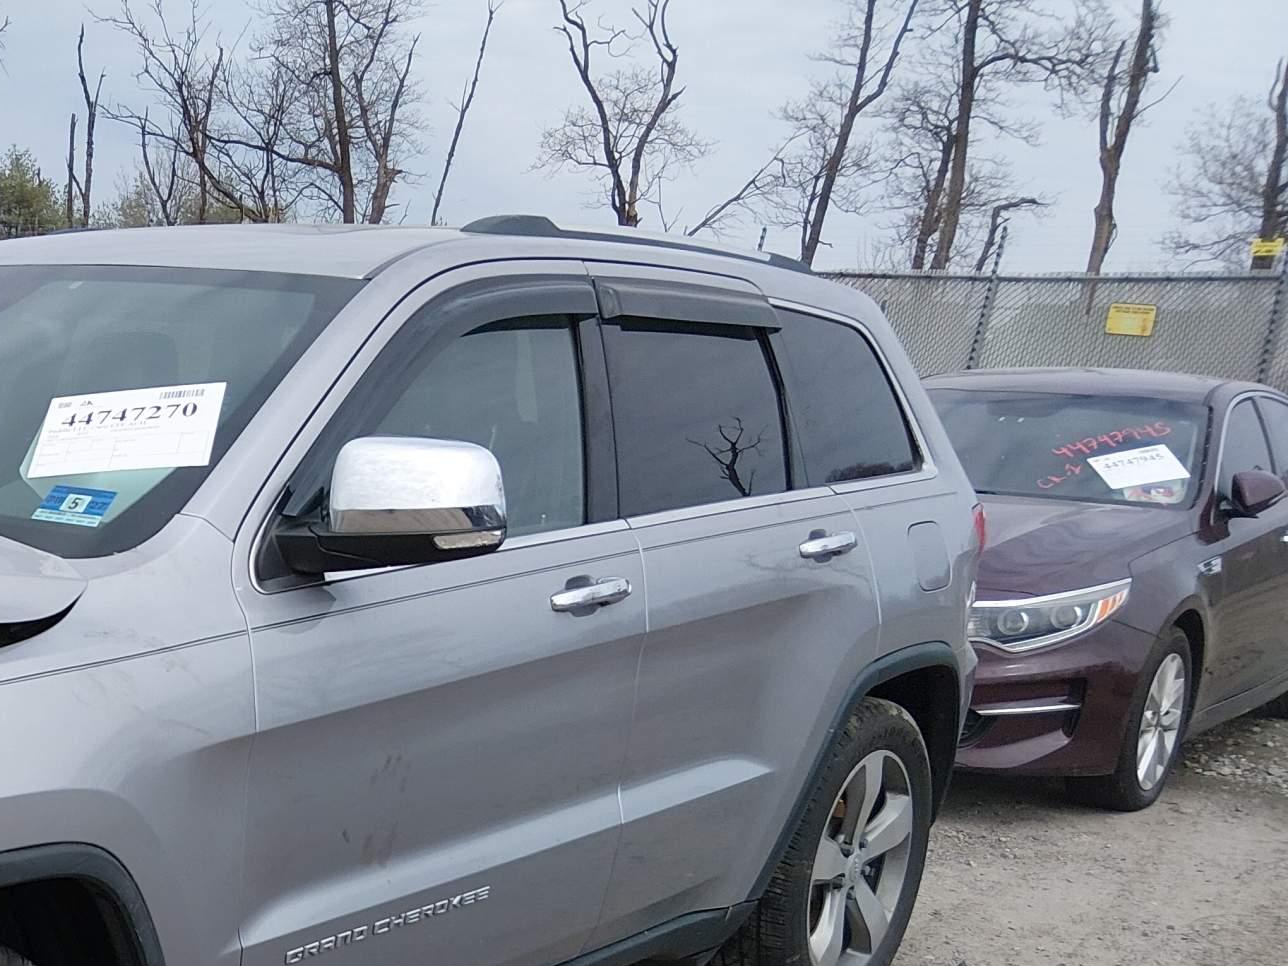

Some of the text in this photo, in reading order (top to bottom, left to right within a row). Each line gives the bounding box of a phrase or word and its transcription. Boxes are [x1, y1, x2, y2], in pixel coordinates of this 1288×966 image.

[61, 402, 198, 427] 44747270
[68, 496, 83, 510] 5
[284, 885, 491, 965] GRAND CHEROKEE
